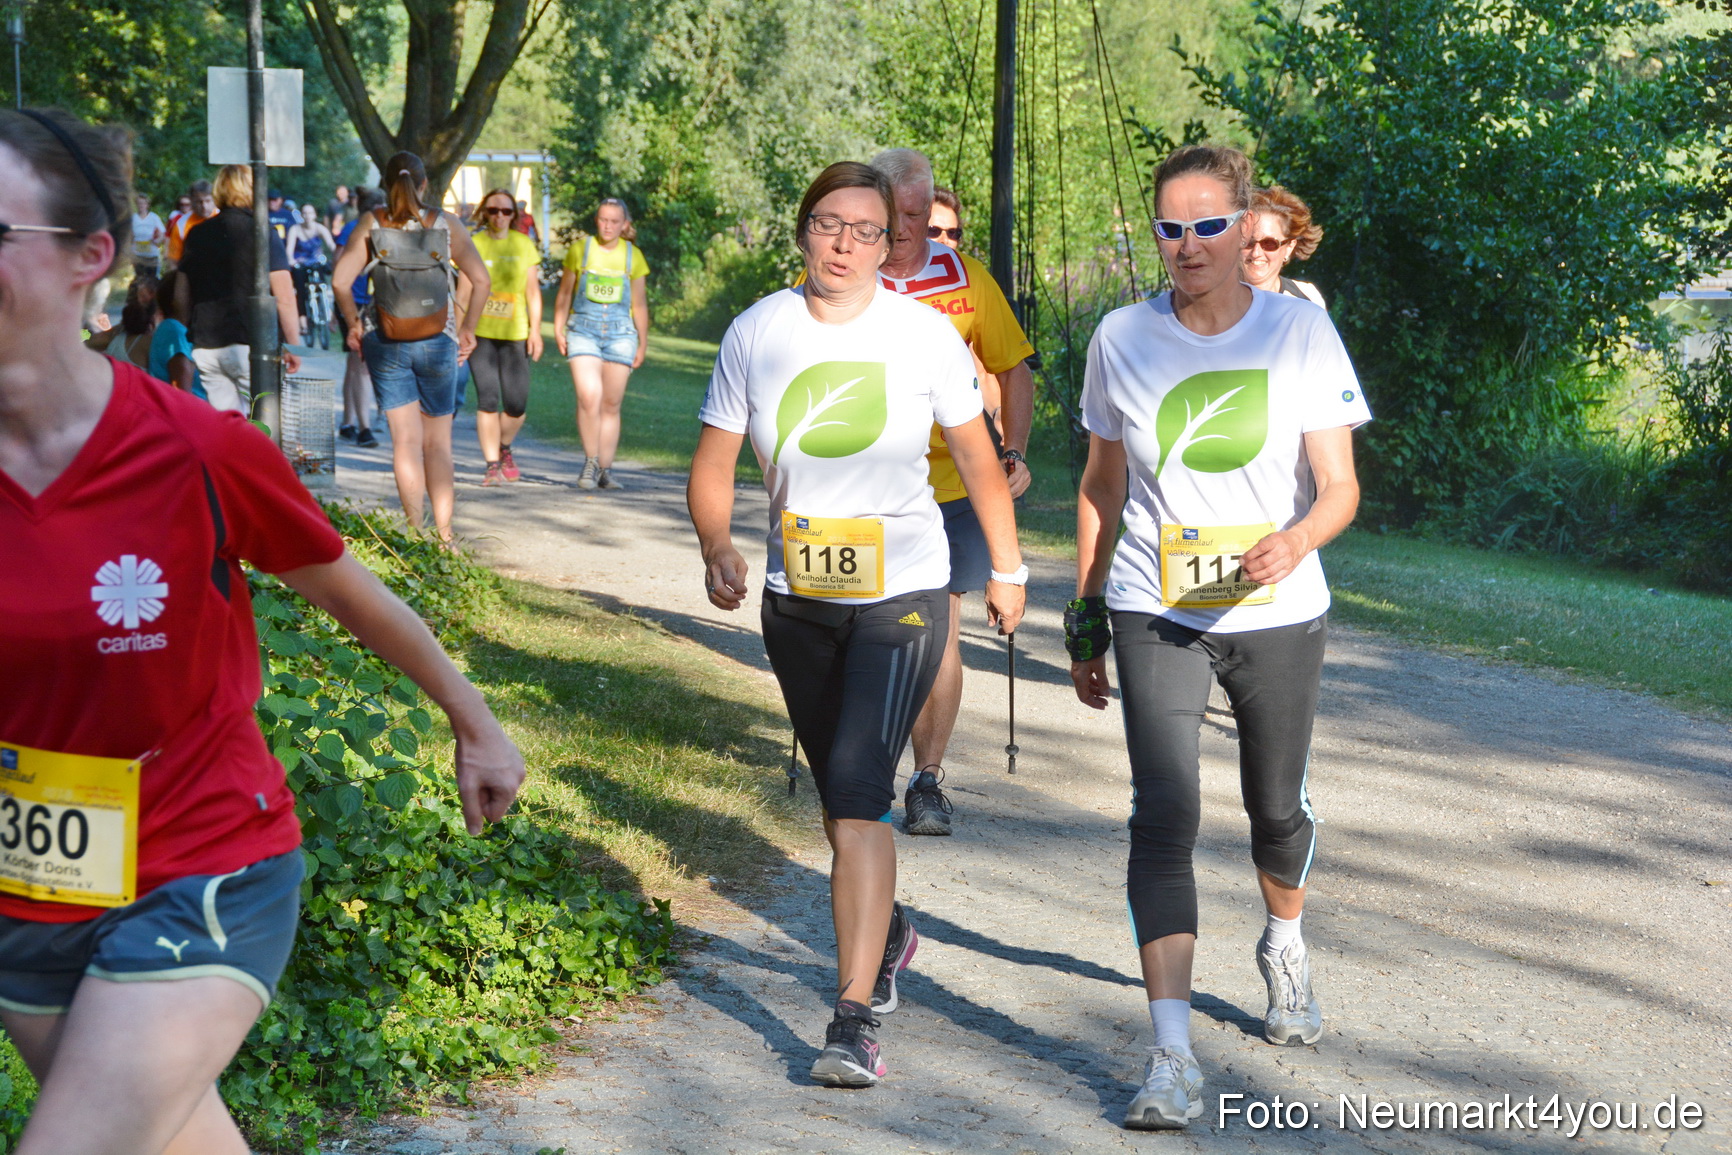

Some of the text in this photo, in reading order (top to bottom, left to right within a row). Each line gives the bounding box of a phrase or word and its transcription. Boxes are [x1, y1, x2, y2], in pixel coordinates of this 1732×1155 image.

[593, 284, 614, 296] 969
[1174, 537, 1214, 546] firmenlauf
[799, 545, 857, 575] 118
[796, 573, 862, 584] Keilhold Claudia
[1179, 584, 1258, 594] Sonnenberg Silvia
[898, 618, 925, 626] adidas
[97, 632, 168, 654] caritas
[0, 797, 89, 860] 360
[45, 861, 82, 877] Doris
